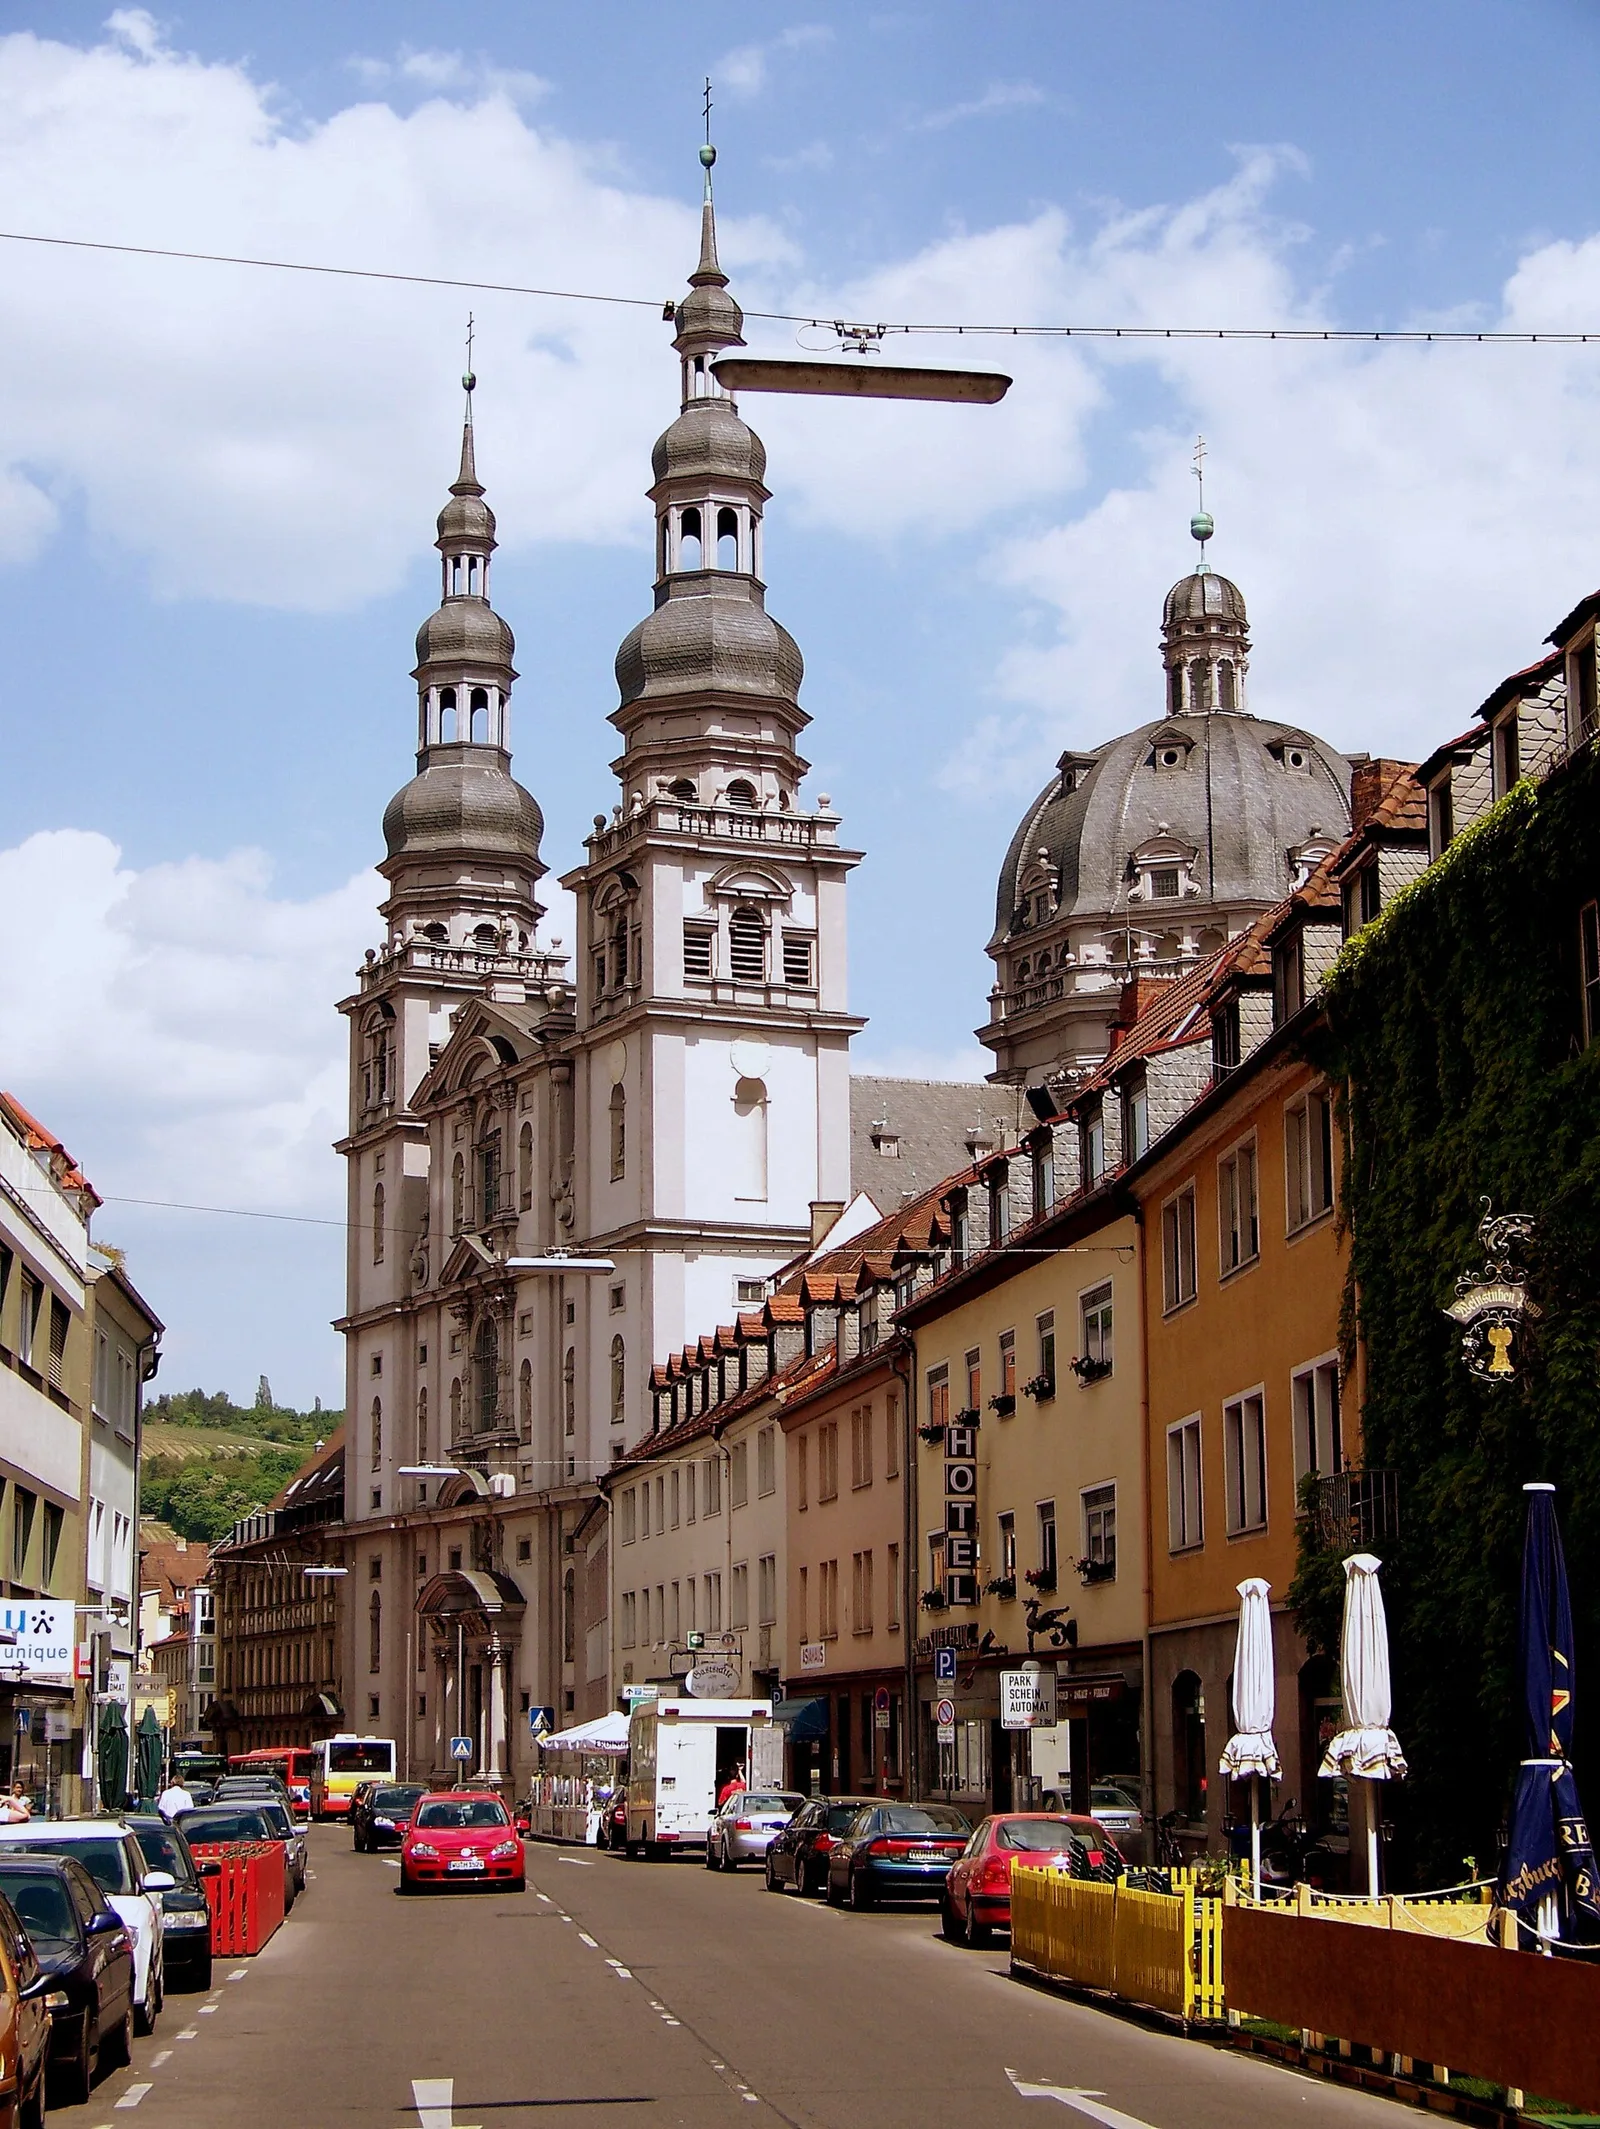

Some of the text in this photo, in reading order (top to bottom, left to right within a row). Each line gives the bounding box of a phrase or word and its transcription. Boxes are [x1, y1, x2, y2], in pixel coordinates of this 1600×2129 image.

[1455, 1288, 1515, 1318] Weinstuben
[950, 1429, 974, 1603] HOTEL
[4, 1644, 68, 1662] unique
[939, 1652, 951, 1677] P
[1009, 1676, 1032, 1687] PARK
[1009, 1688, 1041, 1699] SCHEIN
[1010, 1701, 1050, 1712] AUTOMAT
